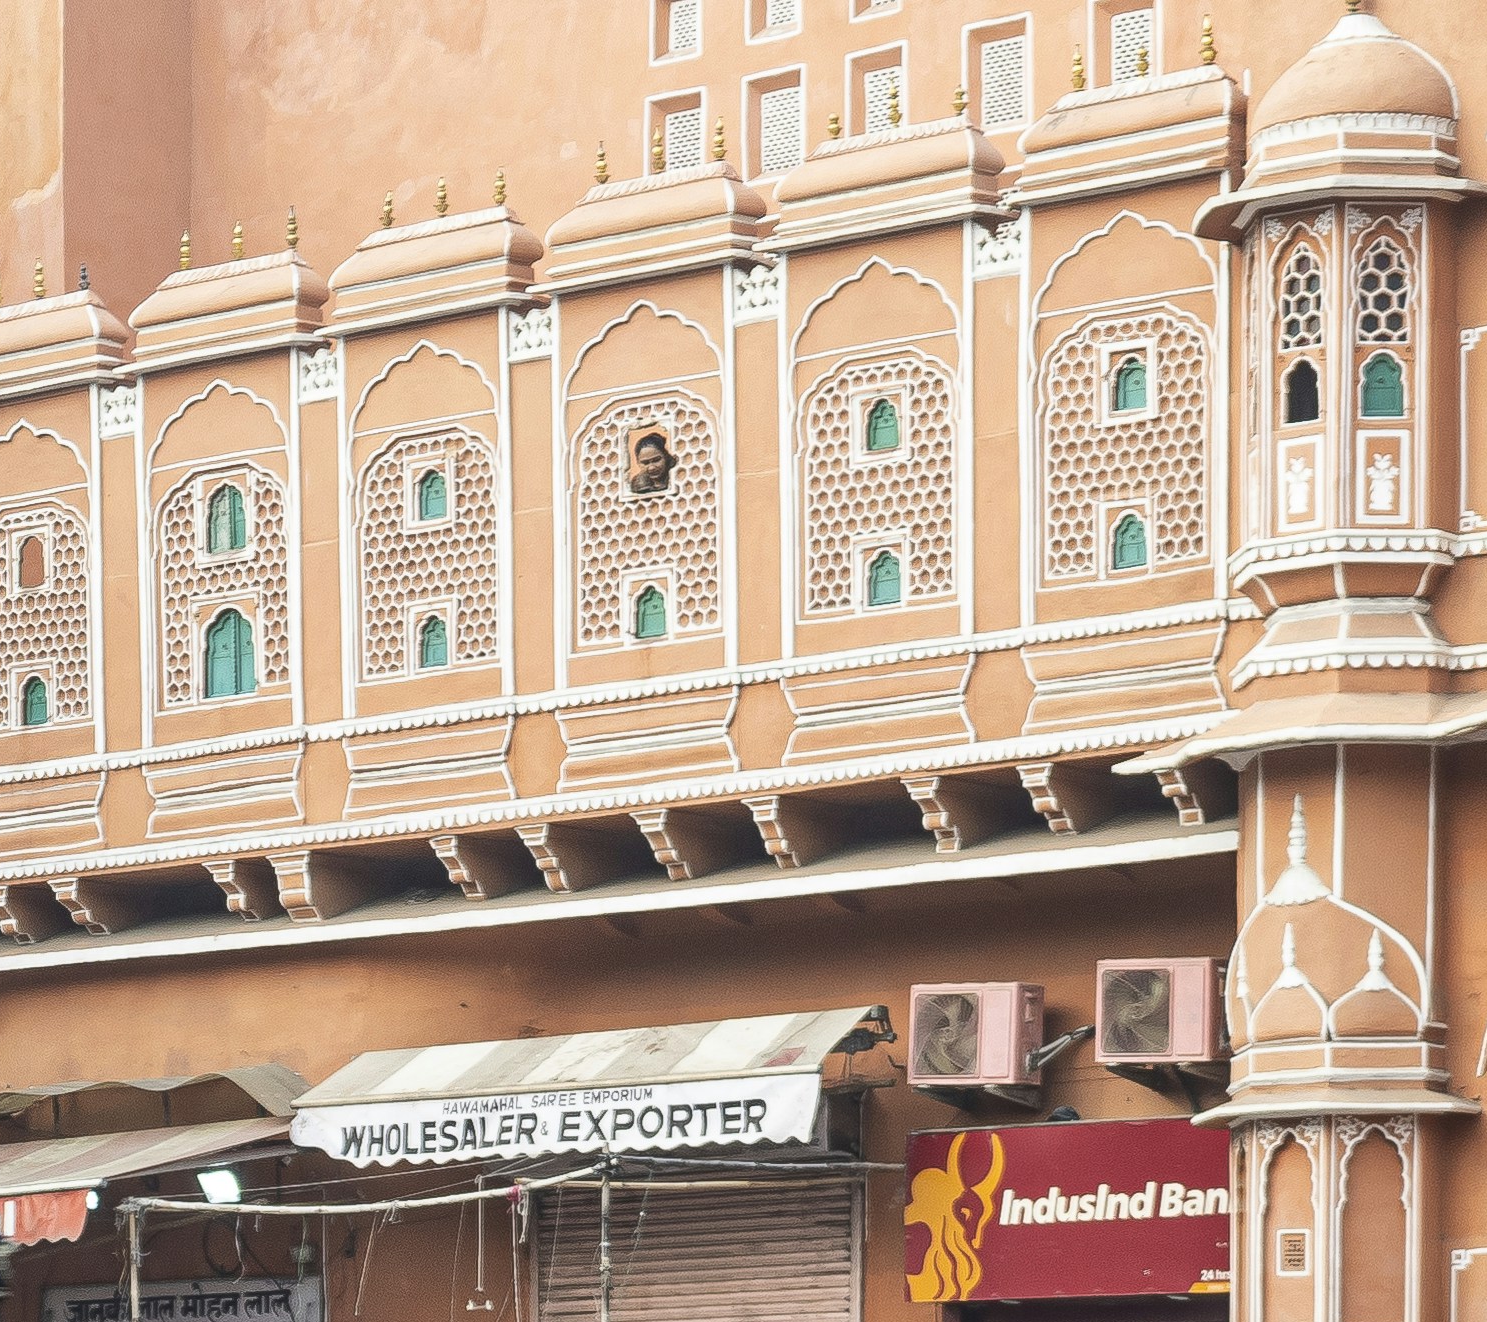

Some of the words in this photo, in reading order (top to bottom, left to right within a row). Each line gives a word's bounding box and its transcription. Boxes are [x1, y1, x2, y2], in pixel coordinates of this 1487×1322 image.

[442, 1095, 523, 1116] HAWAMAHAL
[531, 1092, 576, 1108] SAREE
[582, 1087, 653, 1105] EMPORIUM
[340, 1111, 538, 1159] WHOLESALER
[539, 1120, 549, 1136] &
[558, 1098, 767, 1143] EXPORTER
[999, 1180, 1158, 1226] IndusInd
[1158, 1181, 1231, 1218] Ban
